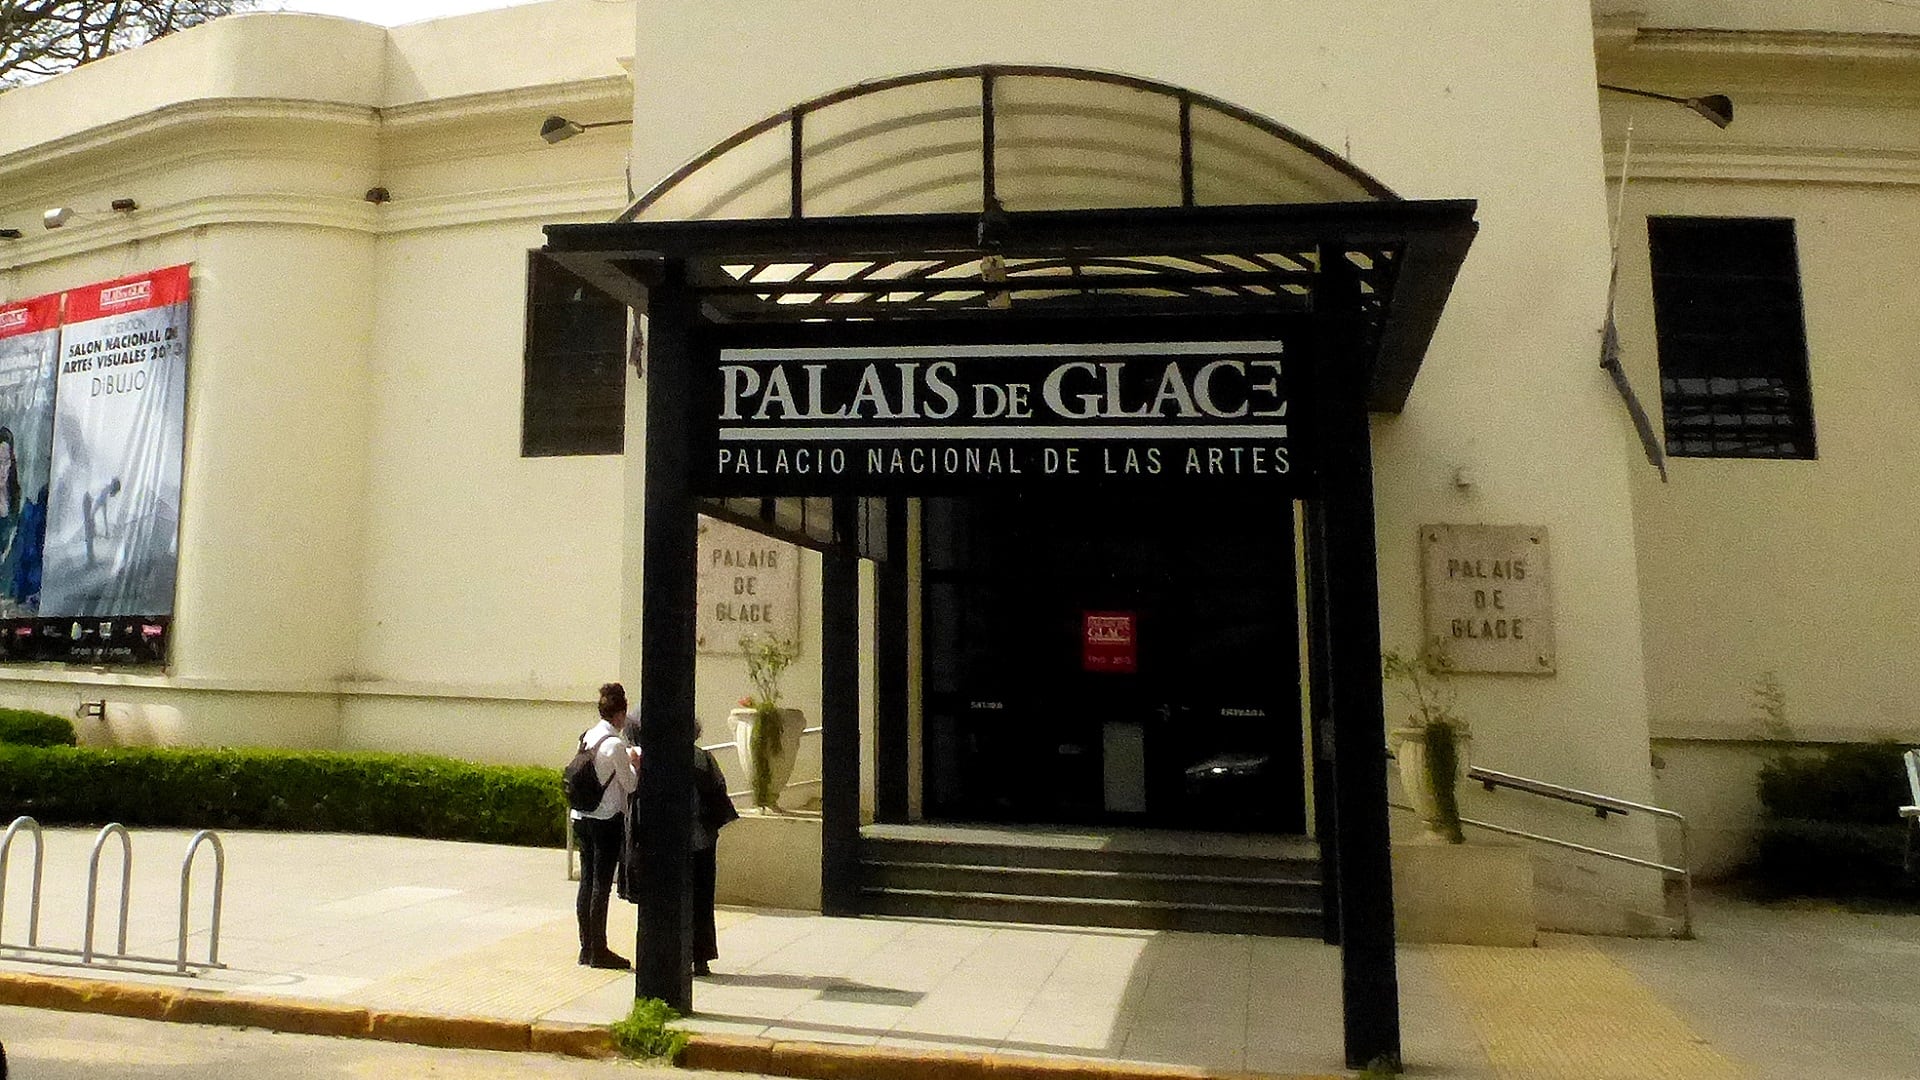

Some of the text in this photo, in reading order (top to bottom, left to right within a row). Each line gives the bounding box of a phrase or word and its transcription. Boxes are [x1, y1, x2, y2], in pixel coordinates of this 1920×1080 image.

[69, 340, 102, 357] SALON
[105, 329, 160, 351] NACIONAL
[63, 357, 92, 374] ARTES
[97, 349, 146, 369] VISUALES
[718, 359, 1288, 420] PALAIS DE GLACE
[718, 446, 1291, 474] PALACIO NACIONAL DE LAS ARTES
[712, 549, 778, 569] PALAIS
[1448, 559, 1526, 580] PALAIS
[734, 576, 757, 596] DE
[1475, 590, 1505, 610] DE
[716, 602, 773, 623] GLACE
[1451, 618, 1524, 641] GLACE
